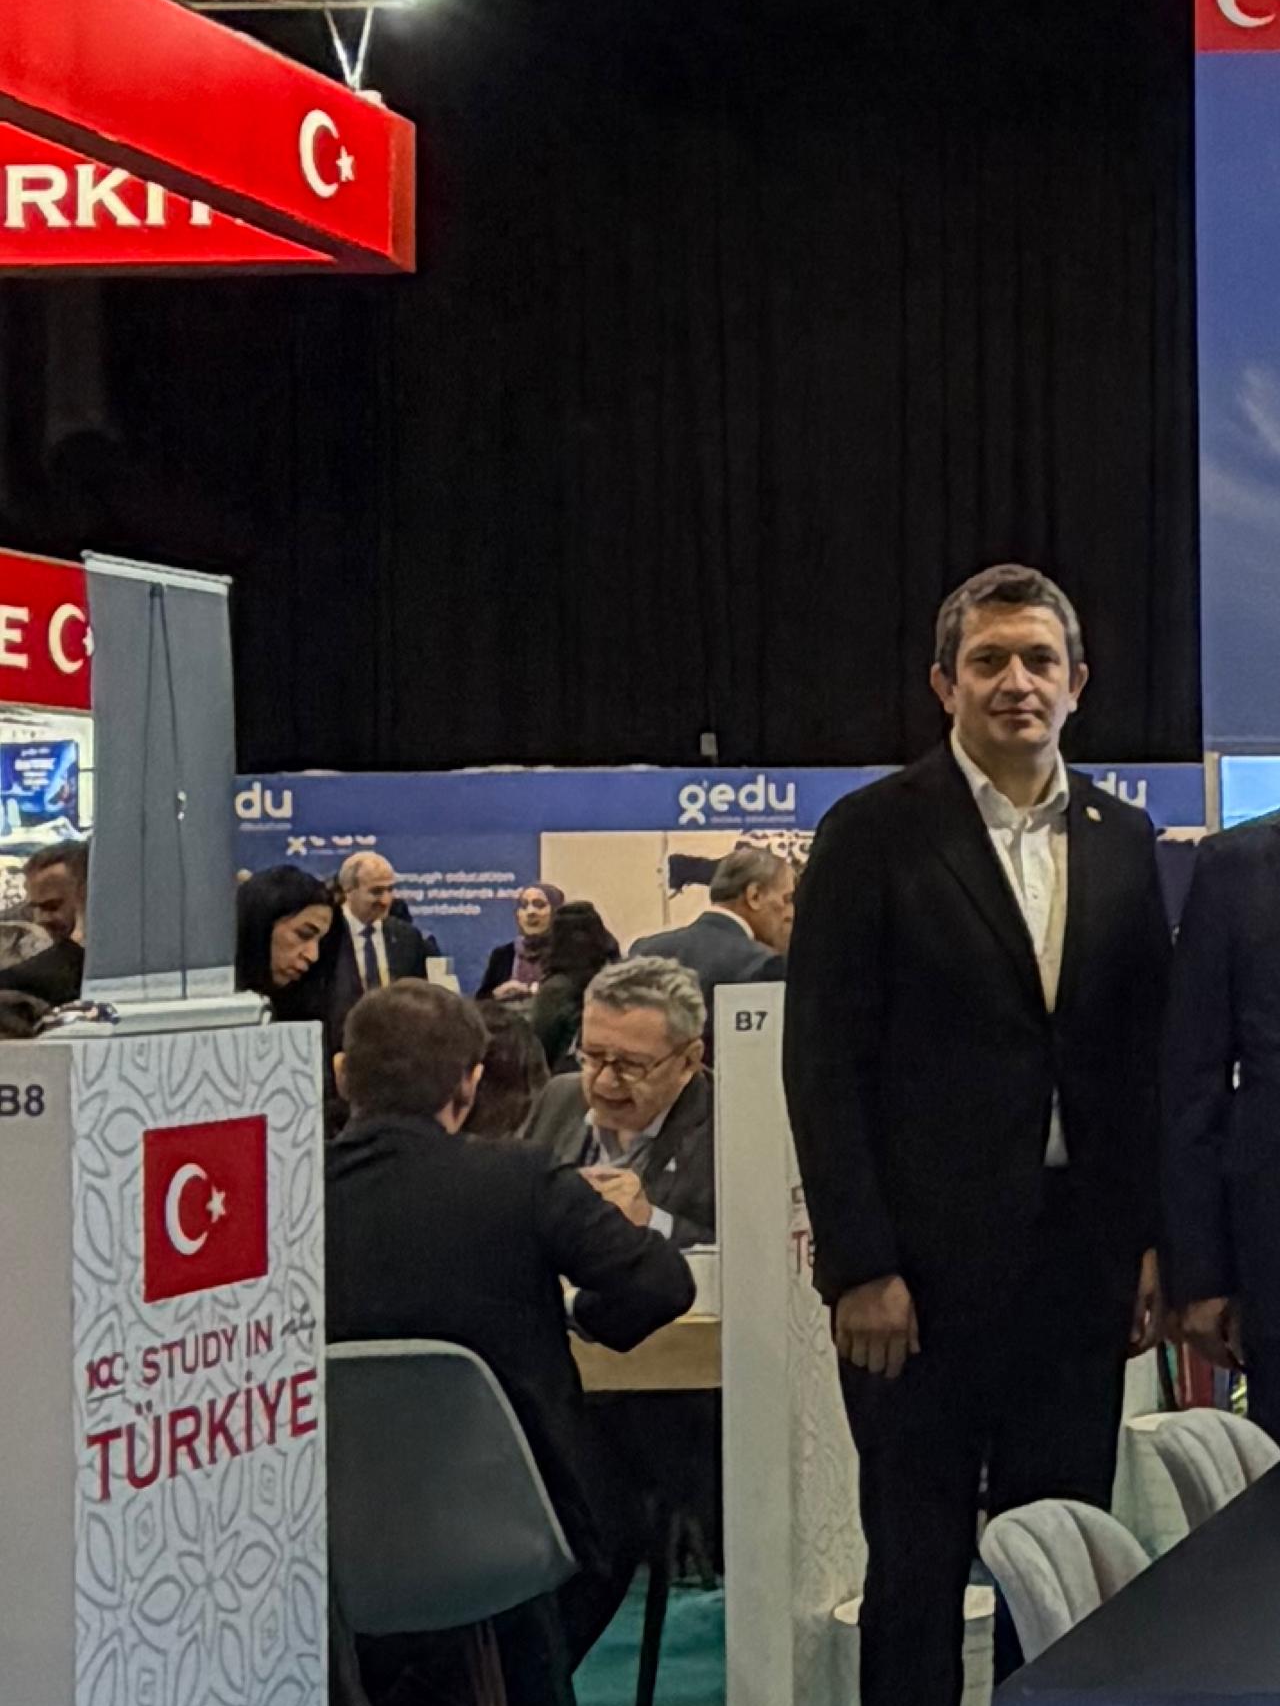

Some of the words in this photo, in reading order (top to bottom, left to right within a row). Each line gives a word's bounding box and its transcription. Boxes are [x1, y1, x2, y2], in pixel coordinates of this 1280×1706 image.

[735, 1011, 768, 1033] B7
[0, 1084, 45, 1117] B8
[141, 1325, 239, 1386] STUDY
[245, 1314, 275, 1358] IN
[86, 1367, 319, 1503] TÜRKİYE
